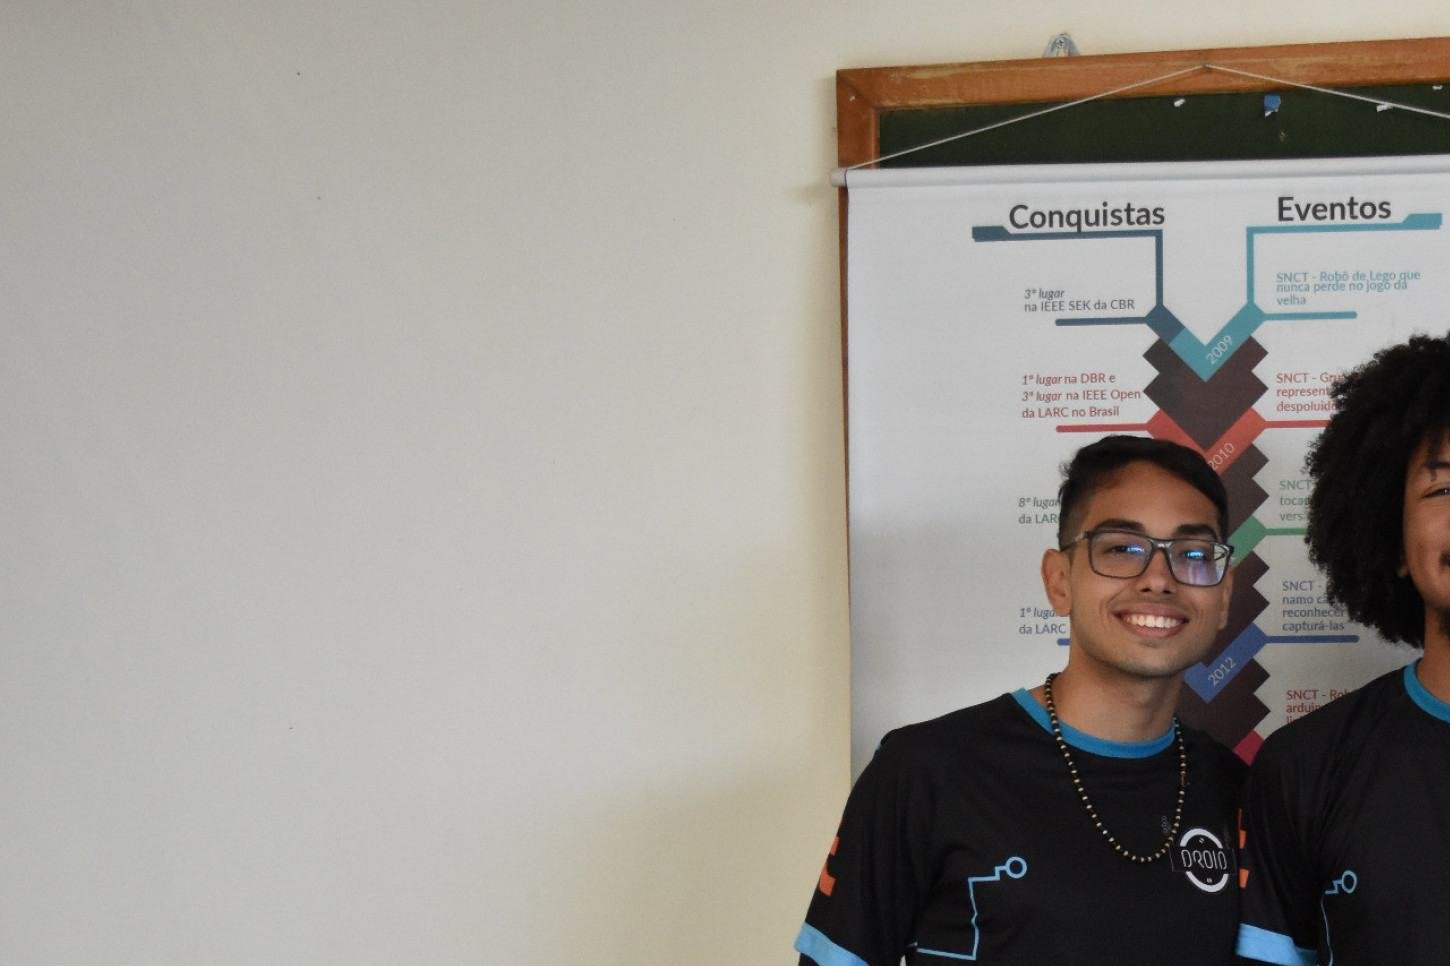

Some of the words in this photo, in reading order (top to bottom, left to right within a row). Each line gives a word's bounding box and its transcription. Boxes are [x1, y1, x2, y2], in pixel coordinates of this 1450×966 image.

[1277, 196, 1392, 222] Eventos
[1009, 201, 1165, 233] Conquistas
[1276, 271, 1308, 283] SNCT
[1352, 270, 1366, 281] de
[1399, 270, 1421, 284] que
[1039, 288, 1065, 301] lugar
[1024, 302, 1037, 312] na
[1040, 301, 1065, 312] IEEE
[1068, 300, 1091, 311] SEK
[1094, 299, 1107, 311] da
[1110, 299, 1135, 310] CBR
[1206, 335, 1233, 365] 2009
[1036, 374, 1062, 387] lugar
[1064, 377, 1077, 385] na
[1081, 373, 1106, 384] DBR
[1109, 375, 1116, 383] e
[1276, 372, 1308, 384] SNCT
[1036, 390, 1062, 403] lugar
[1066, 392, 1079, 401] na
[1082, 390, 1107, 401] IEEE
[1110, 389, 1141, 401] Open
[1022, 408, 1035, 419] da
[1038, 407, 1069, 419] LARC
[1072, 409, 1086, 417] no
[1089, 406, 1120, 418] Brasil
[1207, 442, 1235, 470] 2010
[1018, 513, 1032, 524] da
[1035, 513, 1060, 524] LAR
[1282, 580, 1314, 591] SNCT
[1033, 607, 1057, 620] luga
[1019, 623, 1033, 634] da
[1035, 623, 1067, 634] LARC
[1282, 619, 1345, 633] capturá-las
[1208, 656, 1237, 687] 2012
[1286, 689, 1319, 700] SNCT
[1181, 849, 1228, 870] DROID
